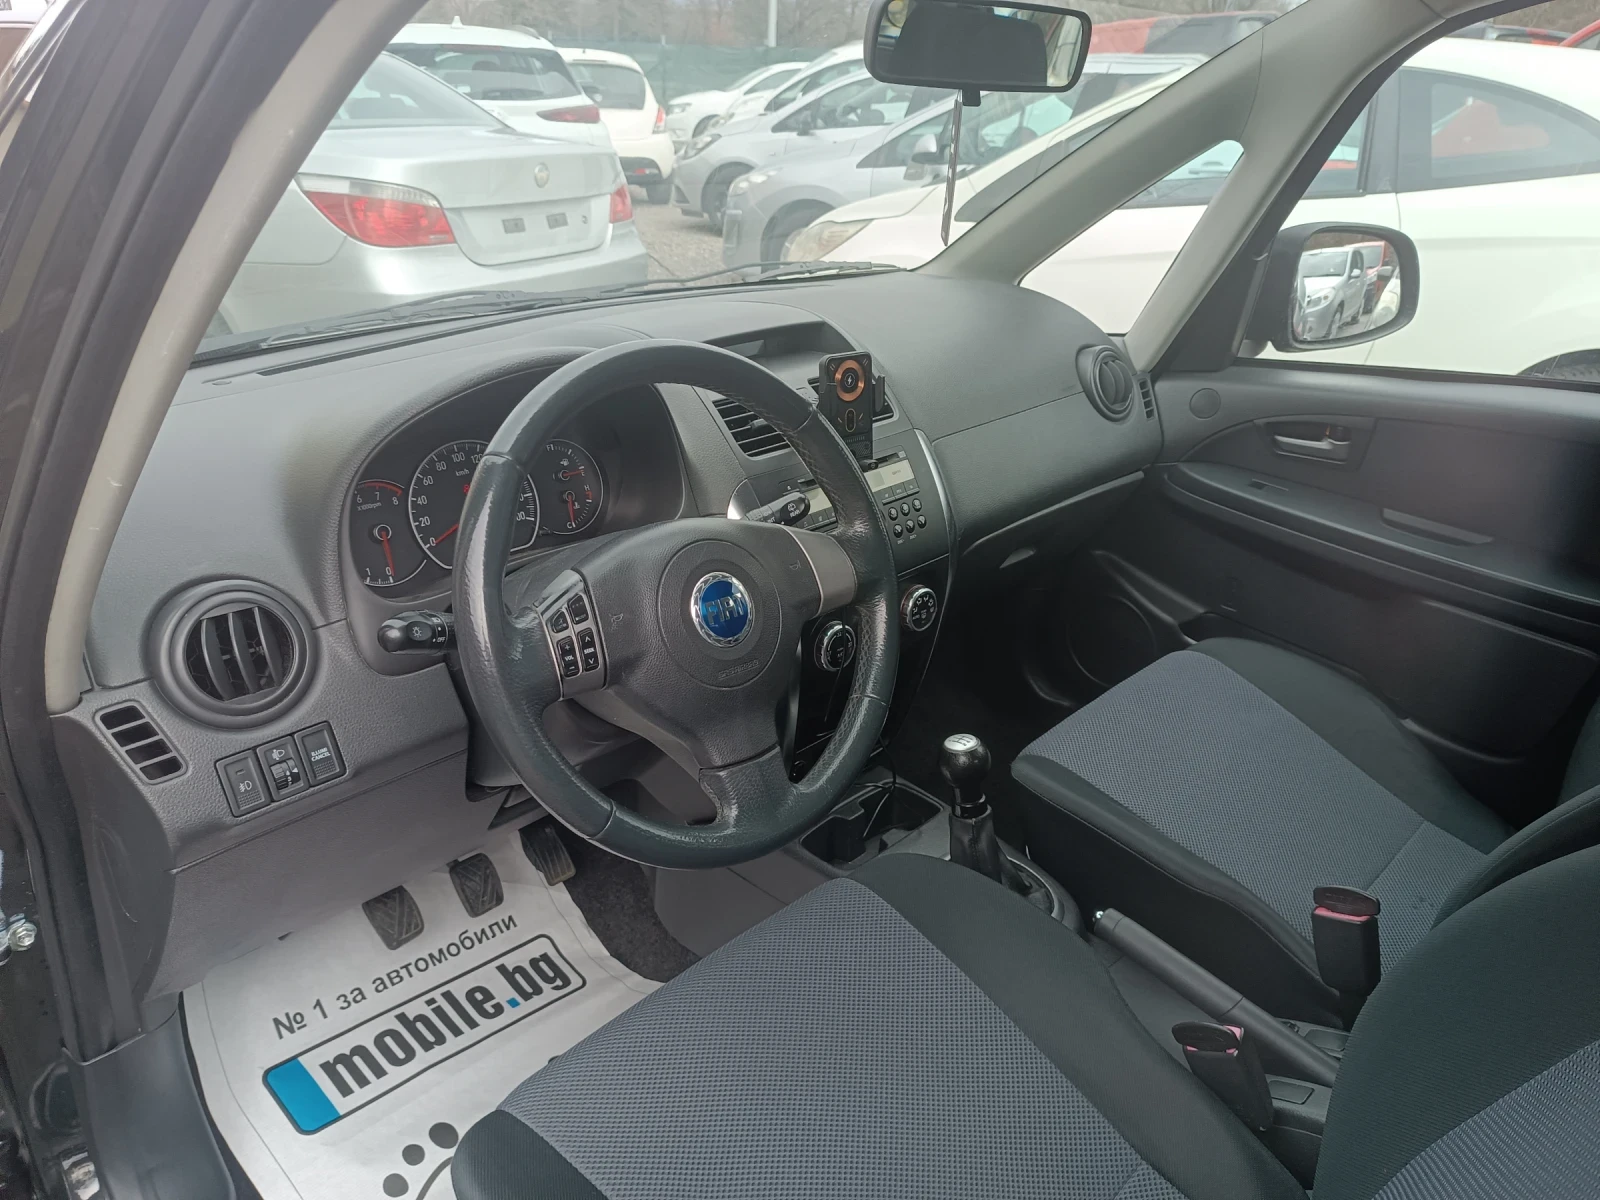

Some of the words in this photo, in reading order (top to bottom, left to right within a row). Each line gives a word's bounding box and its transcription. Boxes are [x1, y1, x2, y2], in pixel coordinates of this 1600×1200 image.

[452, 452, 465, 462] 100
[436, 461, 447, 471] 80
[423, 475, 433, 486] 60
[356, 494, 362, 503] 6
[374, 491, 380, 500] 7
[392, 496, 399, 505] 8
[417, 495, 427, 505] 40
[419, 516, 430, 527] 20
[429, 537, 436, 546] 0
[365, 567, 371, 576] 1
[385, 566, 392, 576] 0
[311, 751, 331, 762] CANCEL
[272, 1009, 308, 1040] №
[313, 998, 329, 1020] 1
[335, 986, 368, 1011] за
[371, 914, 518, 994] автомобили
[318, 951, 572, 1099] mobile.bg
